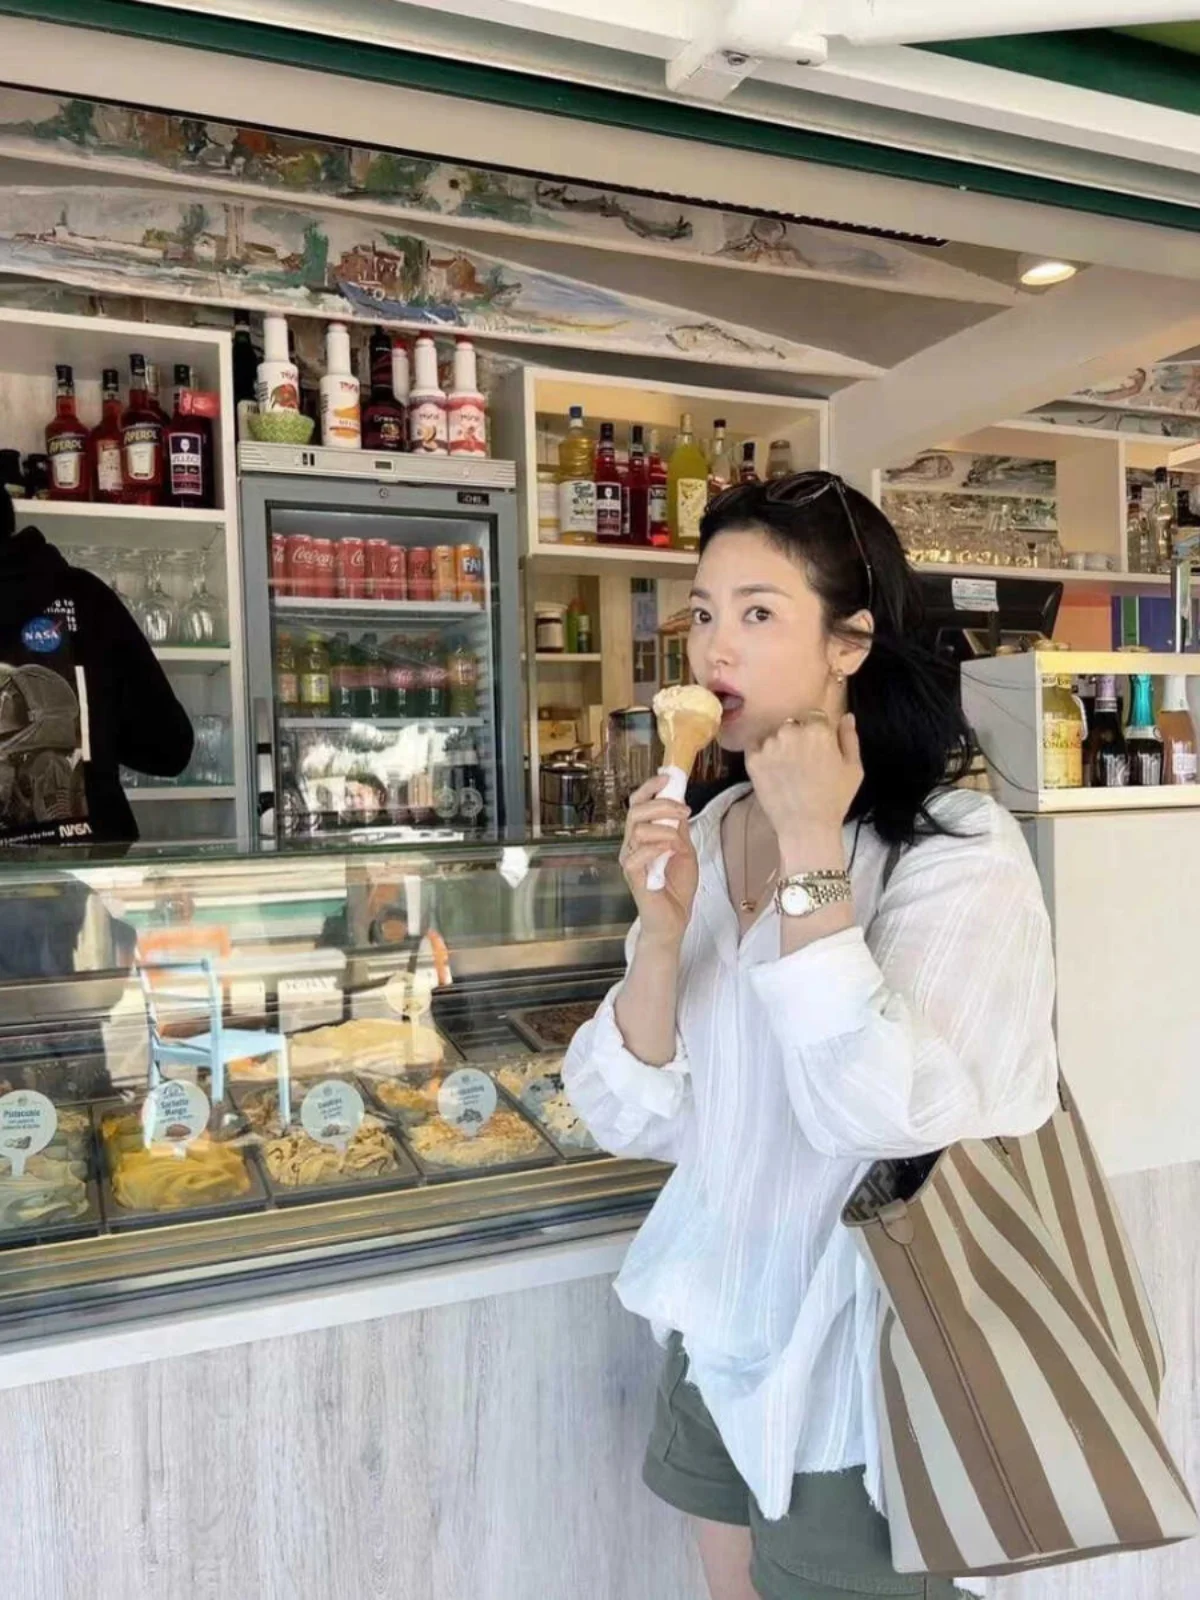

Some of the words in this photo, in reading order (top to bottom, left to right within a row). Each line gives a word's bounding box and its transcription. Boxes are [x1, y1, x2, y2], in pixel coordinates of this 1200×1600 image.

[124, 429, 157, 443] APEROL
[50, 439, 82, 453] APEROL
[24, 631, 59, 641] NASA
[59, 822, 92, 838] NASA
